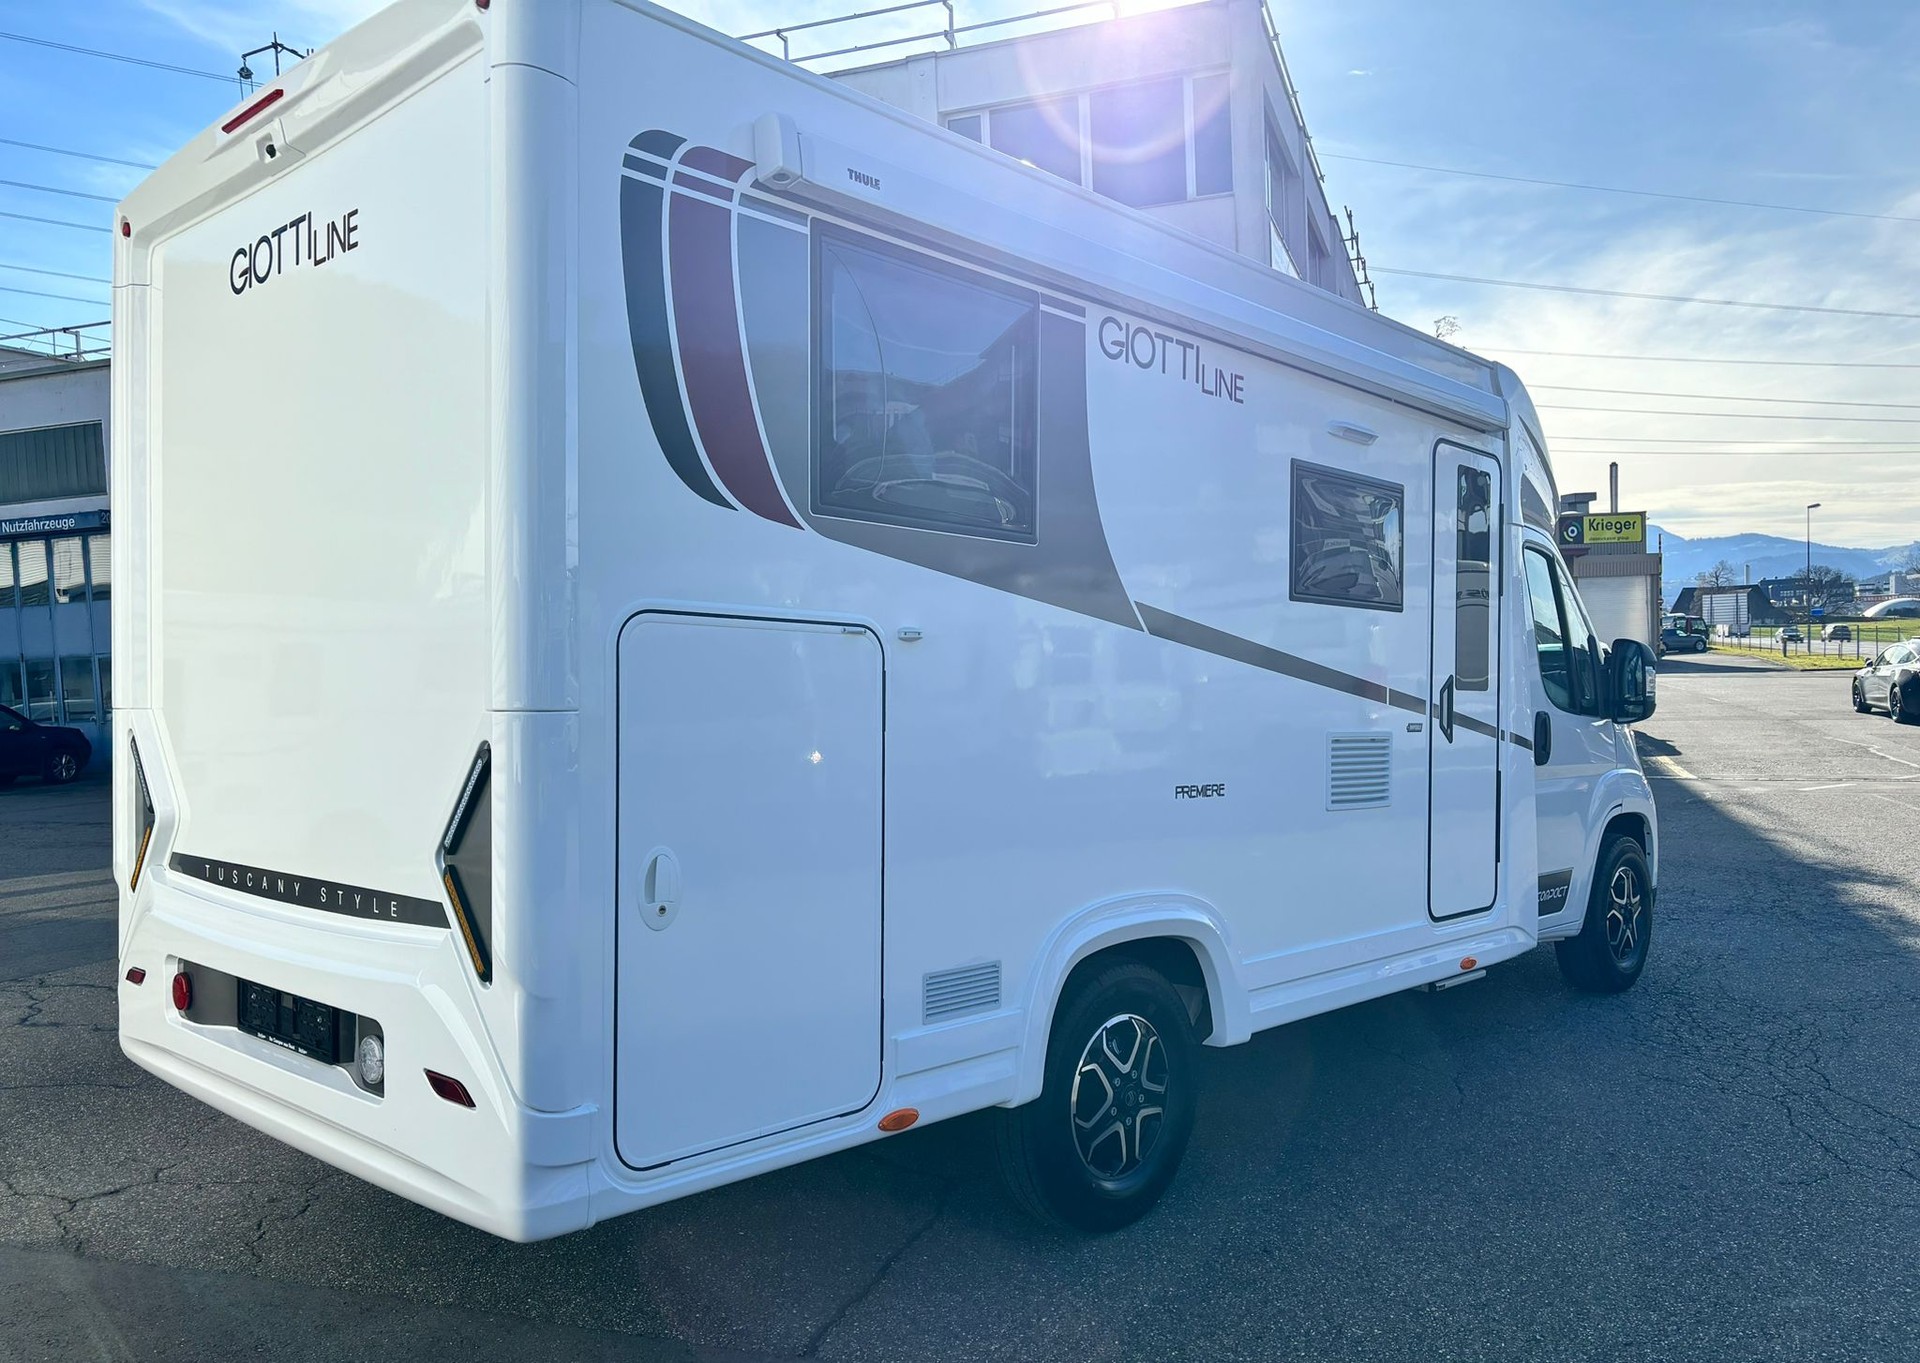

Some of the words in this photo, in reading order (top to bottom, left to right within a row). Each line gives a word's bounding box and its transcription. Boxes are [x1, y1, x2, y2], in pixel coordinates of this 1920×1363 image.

[847, 168, 880, 190] THULE
[2, 518, 75, 533] Nutzfahrzeuge
[1588, 518, 1636, 534] Krieger
[1175, 783, 1225, 799] PREMIERE
[205, 864, 300, 897] TUSCANY
[320, 887, 397, 917] STYLE
